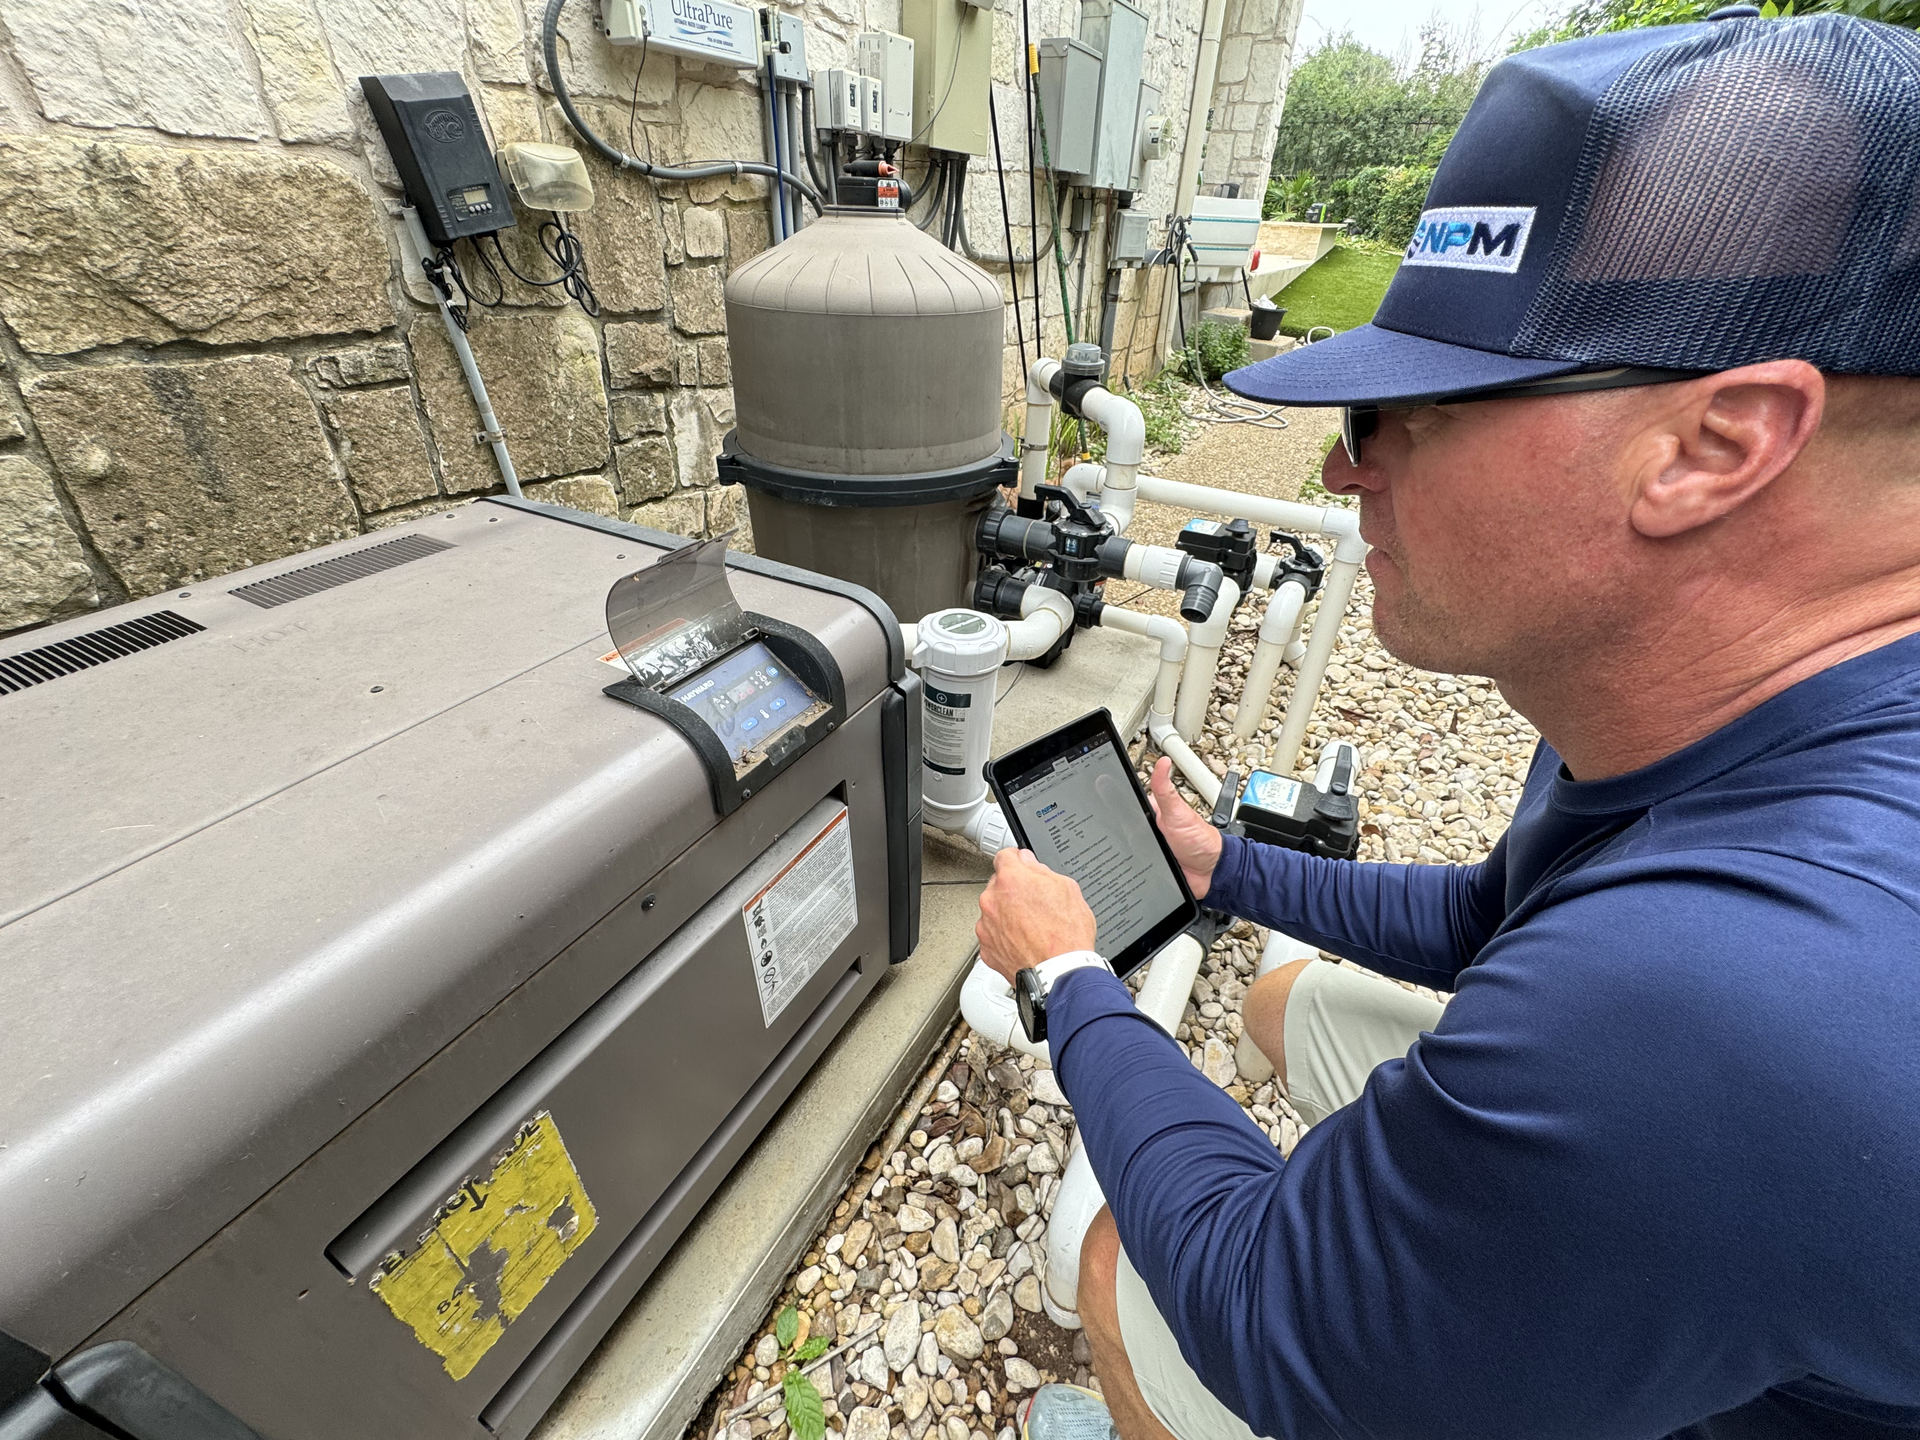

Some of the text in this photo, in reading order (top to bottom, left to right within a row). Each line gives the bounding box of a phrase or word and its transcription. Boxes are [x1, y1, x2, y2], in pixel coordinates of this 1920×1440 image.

[672, 0, 734, 30] UltraPure
[1419, 221, 1521, 257] NPM
[681, 680, 715, 702] HAYWARD
